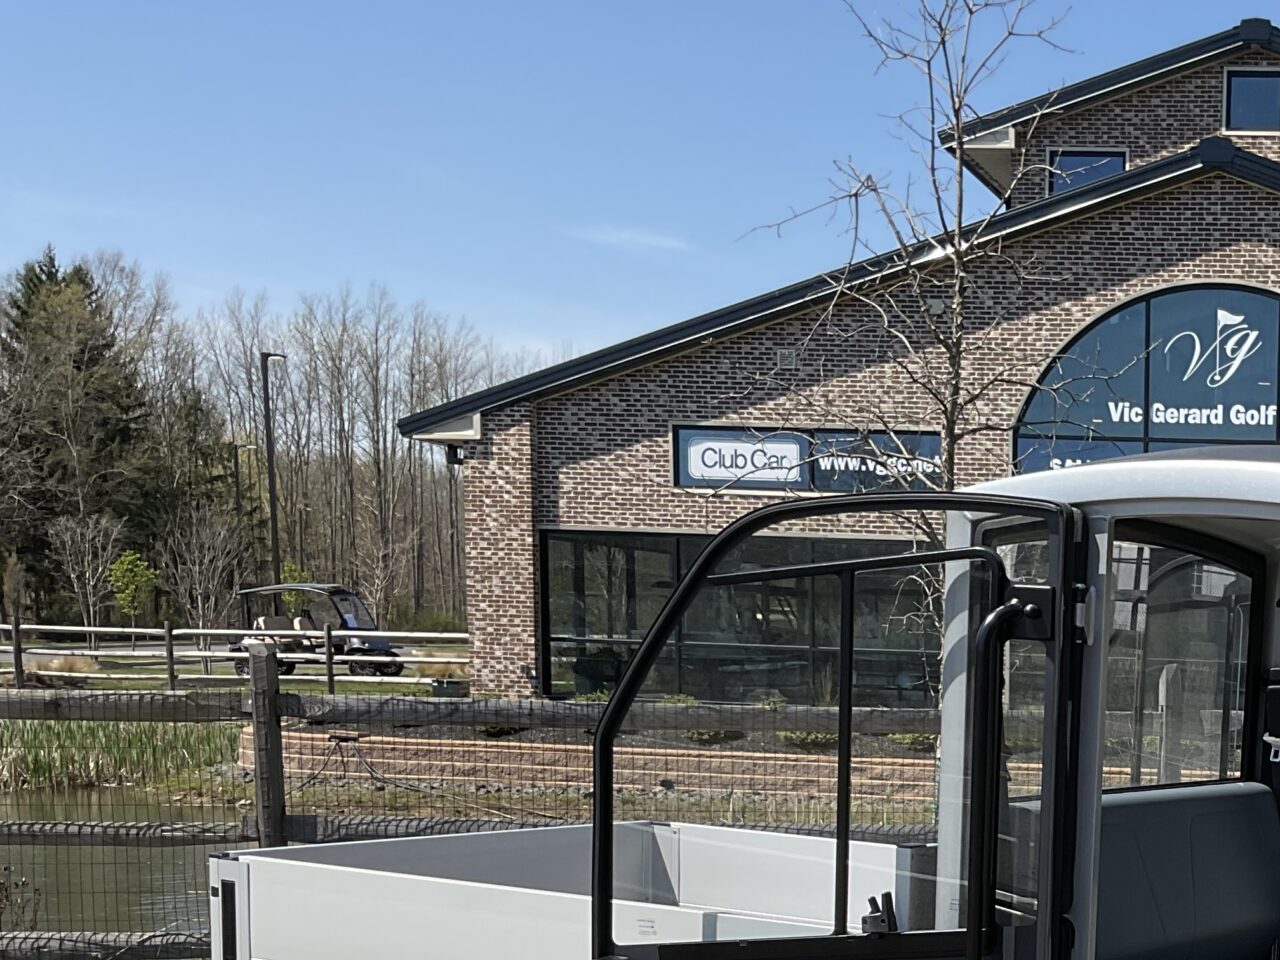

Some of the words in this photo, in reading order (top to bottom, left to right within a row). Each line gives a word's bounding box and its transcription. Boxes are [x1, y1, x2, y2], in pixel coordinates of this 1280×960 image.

[1108, 402, 1143, 424] Vic
[1152, 403, 1223, 425] Gerard
[1230, 405, 1276, 425] Golf
[701, 447, 748, 470] Club
[751, 449, 788, 470] Car
